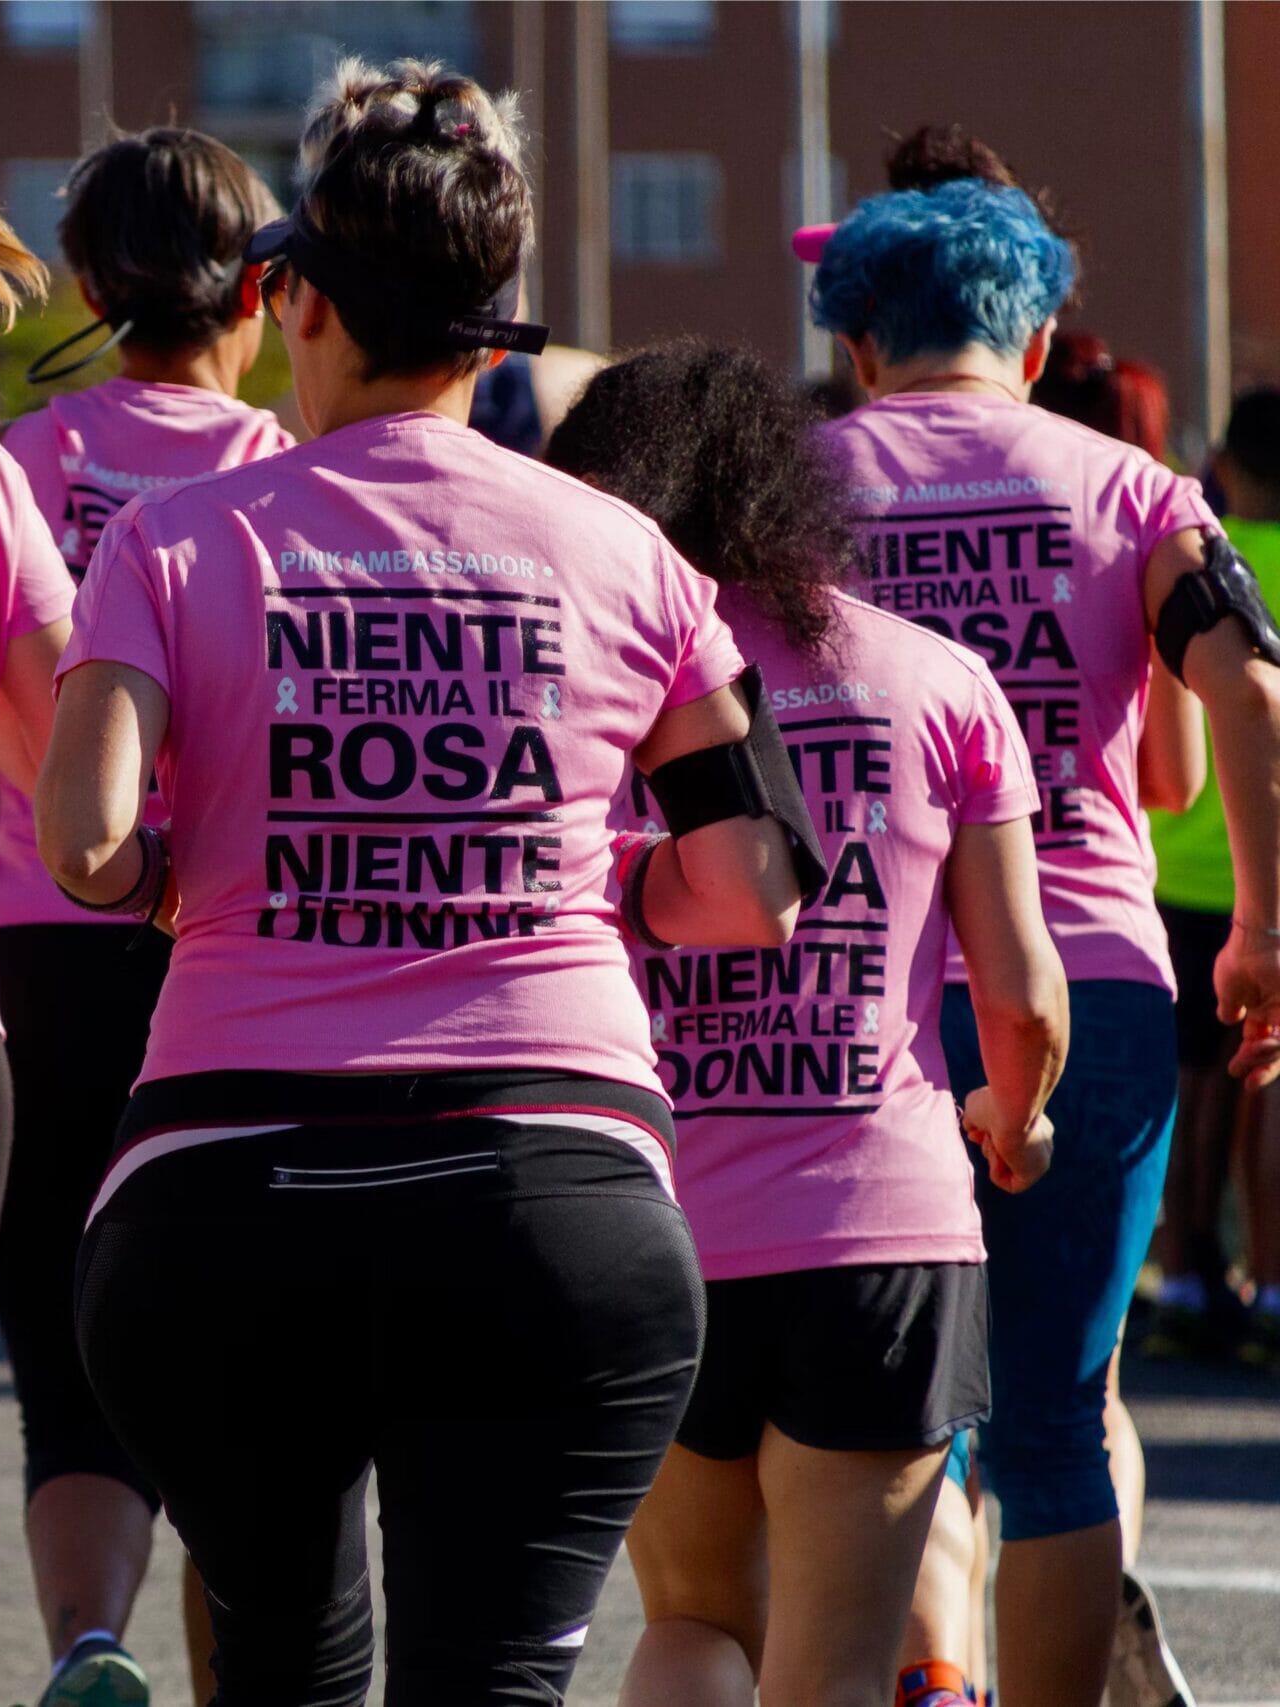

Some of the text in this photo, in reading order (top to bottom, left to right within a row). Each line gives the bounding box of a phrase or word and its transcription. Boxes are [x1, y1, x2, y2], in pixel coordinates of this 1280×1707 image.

[903, 476, 1052, 503] AMBASSADOR
[280, 551, 536, 578] PINK AMBASSADOR
[1011, 575, 1040, 605] IL
[266, 611, 566, 675] NIENTE
[313, 678, 526, 717] FERMA IL
[269, 722, 564, 802] ROSA
[825, 800, 856, 833] IL
[264, 834, 563, 894] NIENTE
[644, 943, 885, 1009] NIENTE
[674, 1004, 856, 1045] FERMA LE
